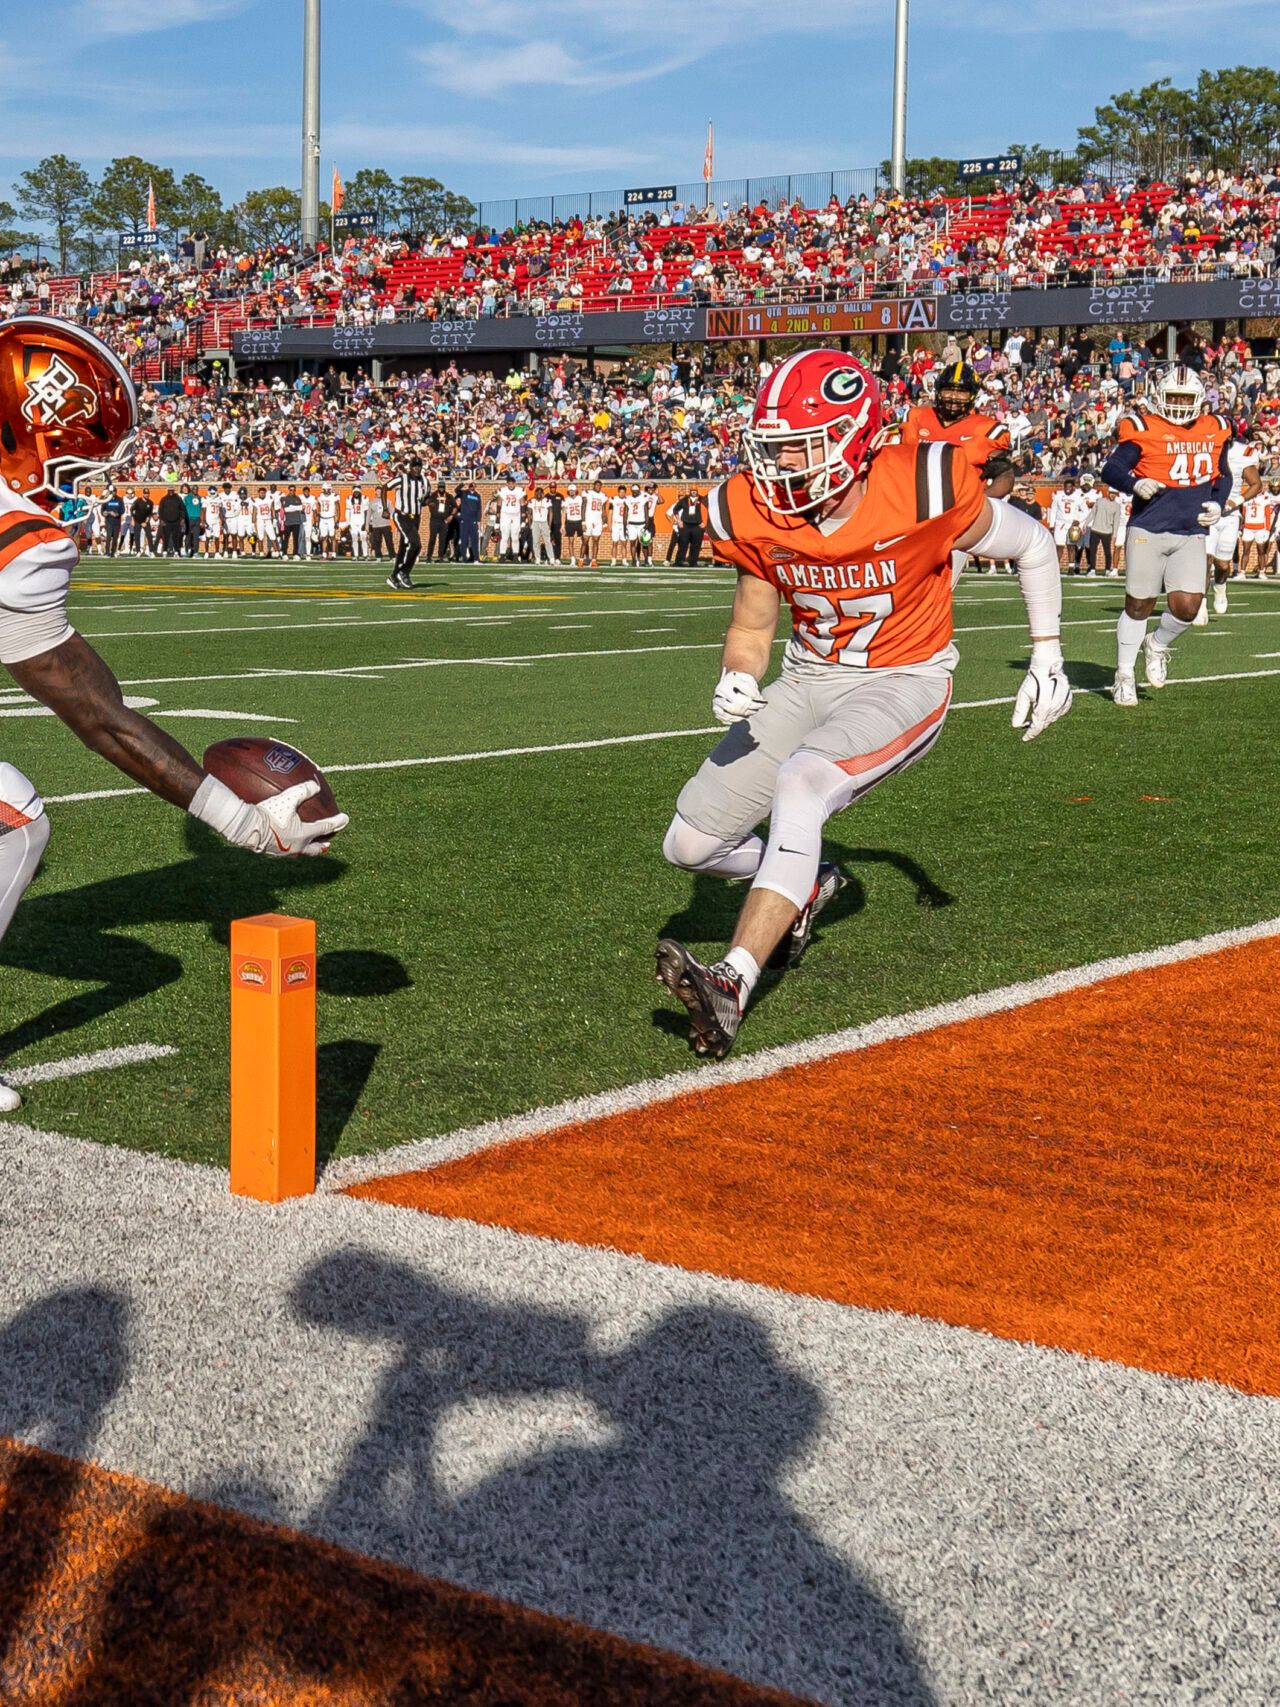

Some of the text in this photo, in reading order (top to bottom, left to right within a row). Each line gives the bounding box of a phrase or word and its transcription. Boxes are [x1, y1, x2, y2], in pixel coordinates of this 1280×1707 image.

[963, 159, 1018, 174] 225 226
[627, 190, 673, 202] 224 225
[335, 216, 373, 226] 223 224
[123, 236, 135, 244] 222
[1089, 284, 1155, 299] PORT
[950, 292, 1011, 307] PORT
[767, 307, 782, 318] QTR
[787, 305, 810, 316] DOWN
[816, 304, 837, 314] TO GO
[844, 302, 872, 313] BALL ON
[950, 307, 1011, 321] CITY
[1089, 300, 1154, 315] CITY
[536, 314, 584, 327] PORT
[644, 309, 696, 321] PORT
[881, 307, 891, 325] 8
[431, 320, 477, 332] PORT
[643, 322, 695, 335] CITY
[747, 314, 761, 331] 11
[771, 320, 778, 333] 4
[786, 319, 809, 333] 2ND
[853, 316, 864, 330] 11
[241, 330, 283, 342] PORT
[333, 325, 376, 337] PORT
[535, 328, 584, 341] CITY
[332, 338, 376, 350] CITY
[430, 333, 476, 346] CITY
[241, 342, 282, 354] CITY
[821, 366, 865, 404] G
[1166, 441, 1215, 455] AMERICAN
[1169, 453, 1213, 486] 40
[1064, 502, 1071, 513] 5
[776, 560, 897, 590] AMERICAN
[792, 591, 894, 668] 37
[267, 752, 294, 770] NFL
